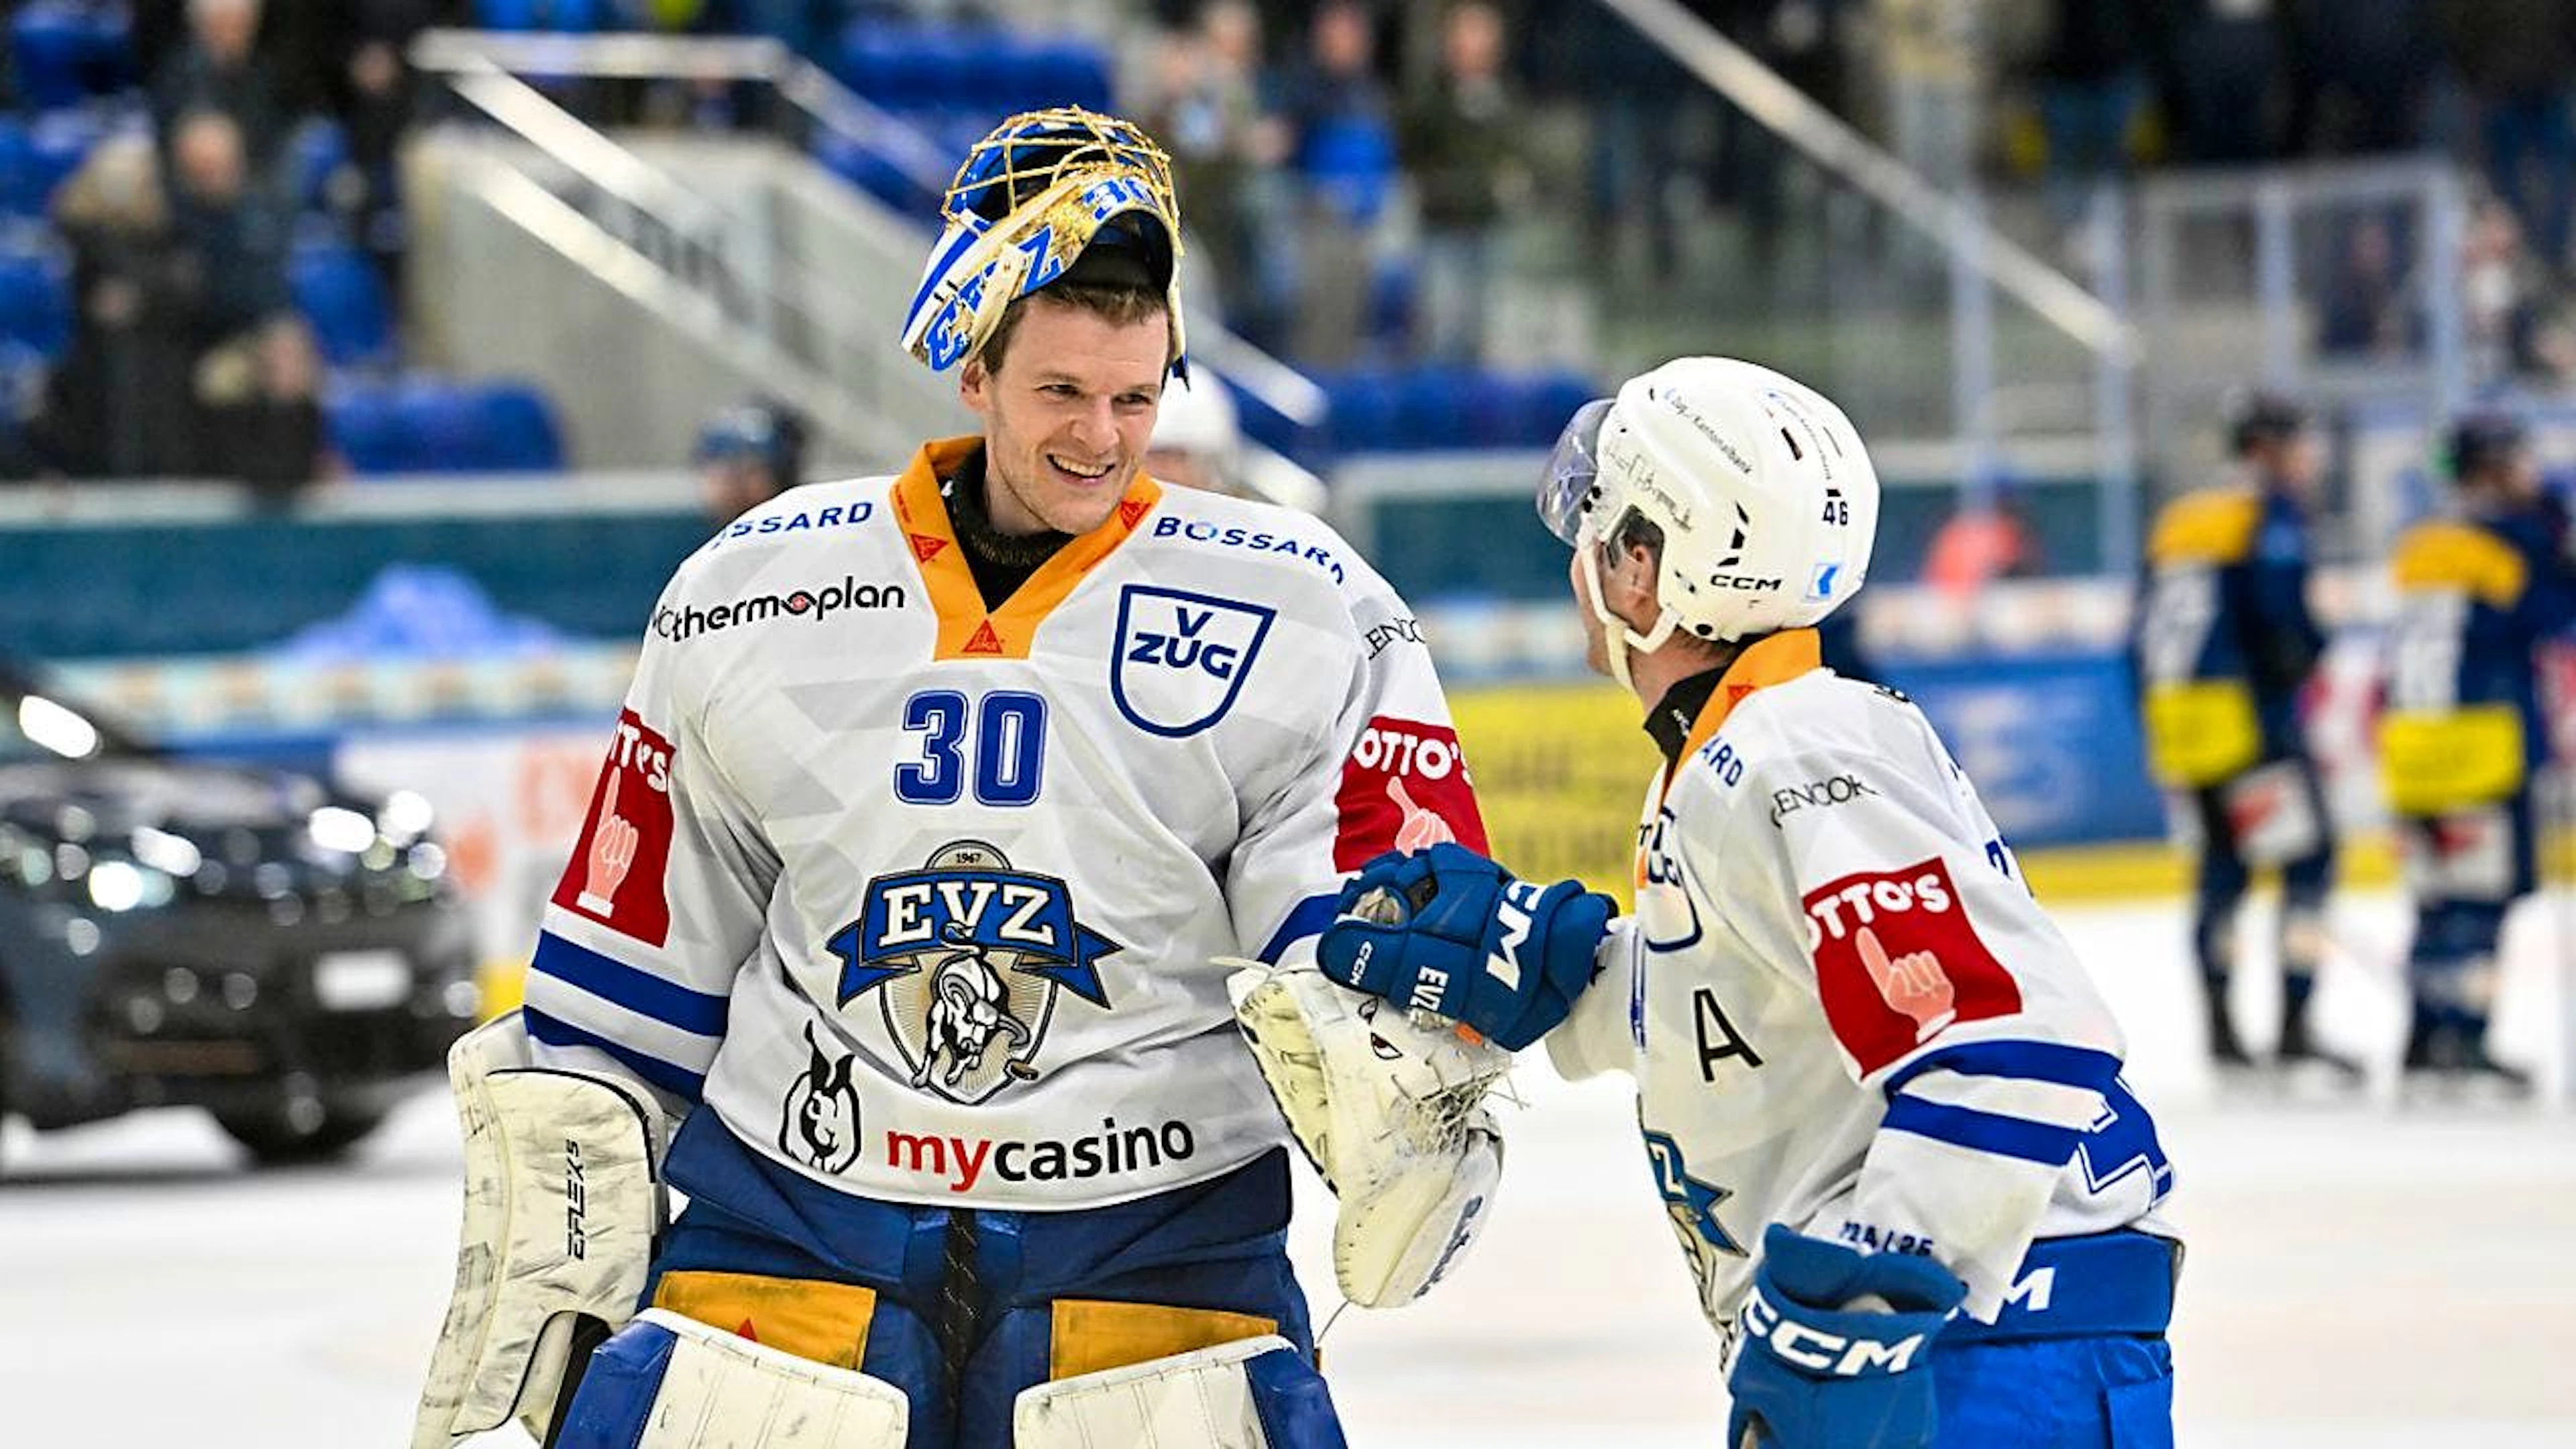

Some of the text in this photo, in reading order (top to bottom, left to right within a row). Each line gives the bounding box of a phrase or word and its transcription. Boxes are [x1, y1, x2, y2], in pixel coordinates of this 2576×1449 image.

[709, 501, 873, 551] SSARD
[1822, 501, 1849, 526] 46
[672, 576, 904, 643] thermoplan
[1709, 574, 1782, 592] CCM
[1176, 607, 1214, 638] V
[1128, 632, 1238, 680] ZUG
[894, 690, 1047, 807] 30
[1701, 737, 1743, 787] ARD
[877, 881, 1056, 948] EVZ
[1485, 879, 1549, 992] CM
[1349, 941, 1373, 986] CCM
[1693, 987, 1764, 1083] A
[887, 1118, 1195, 1192] mycasino
[1743, 1284, 1925, 1377] CCM
